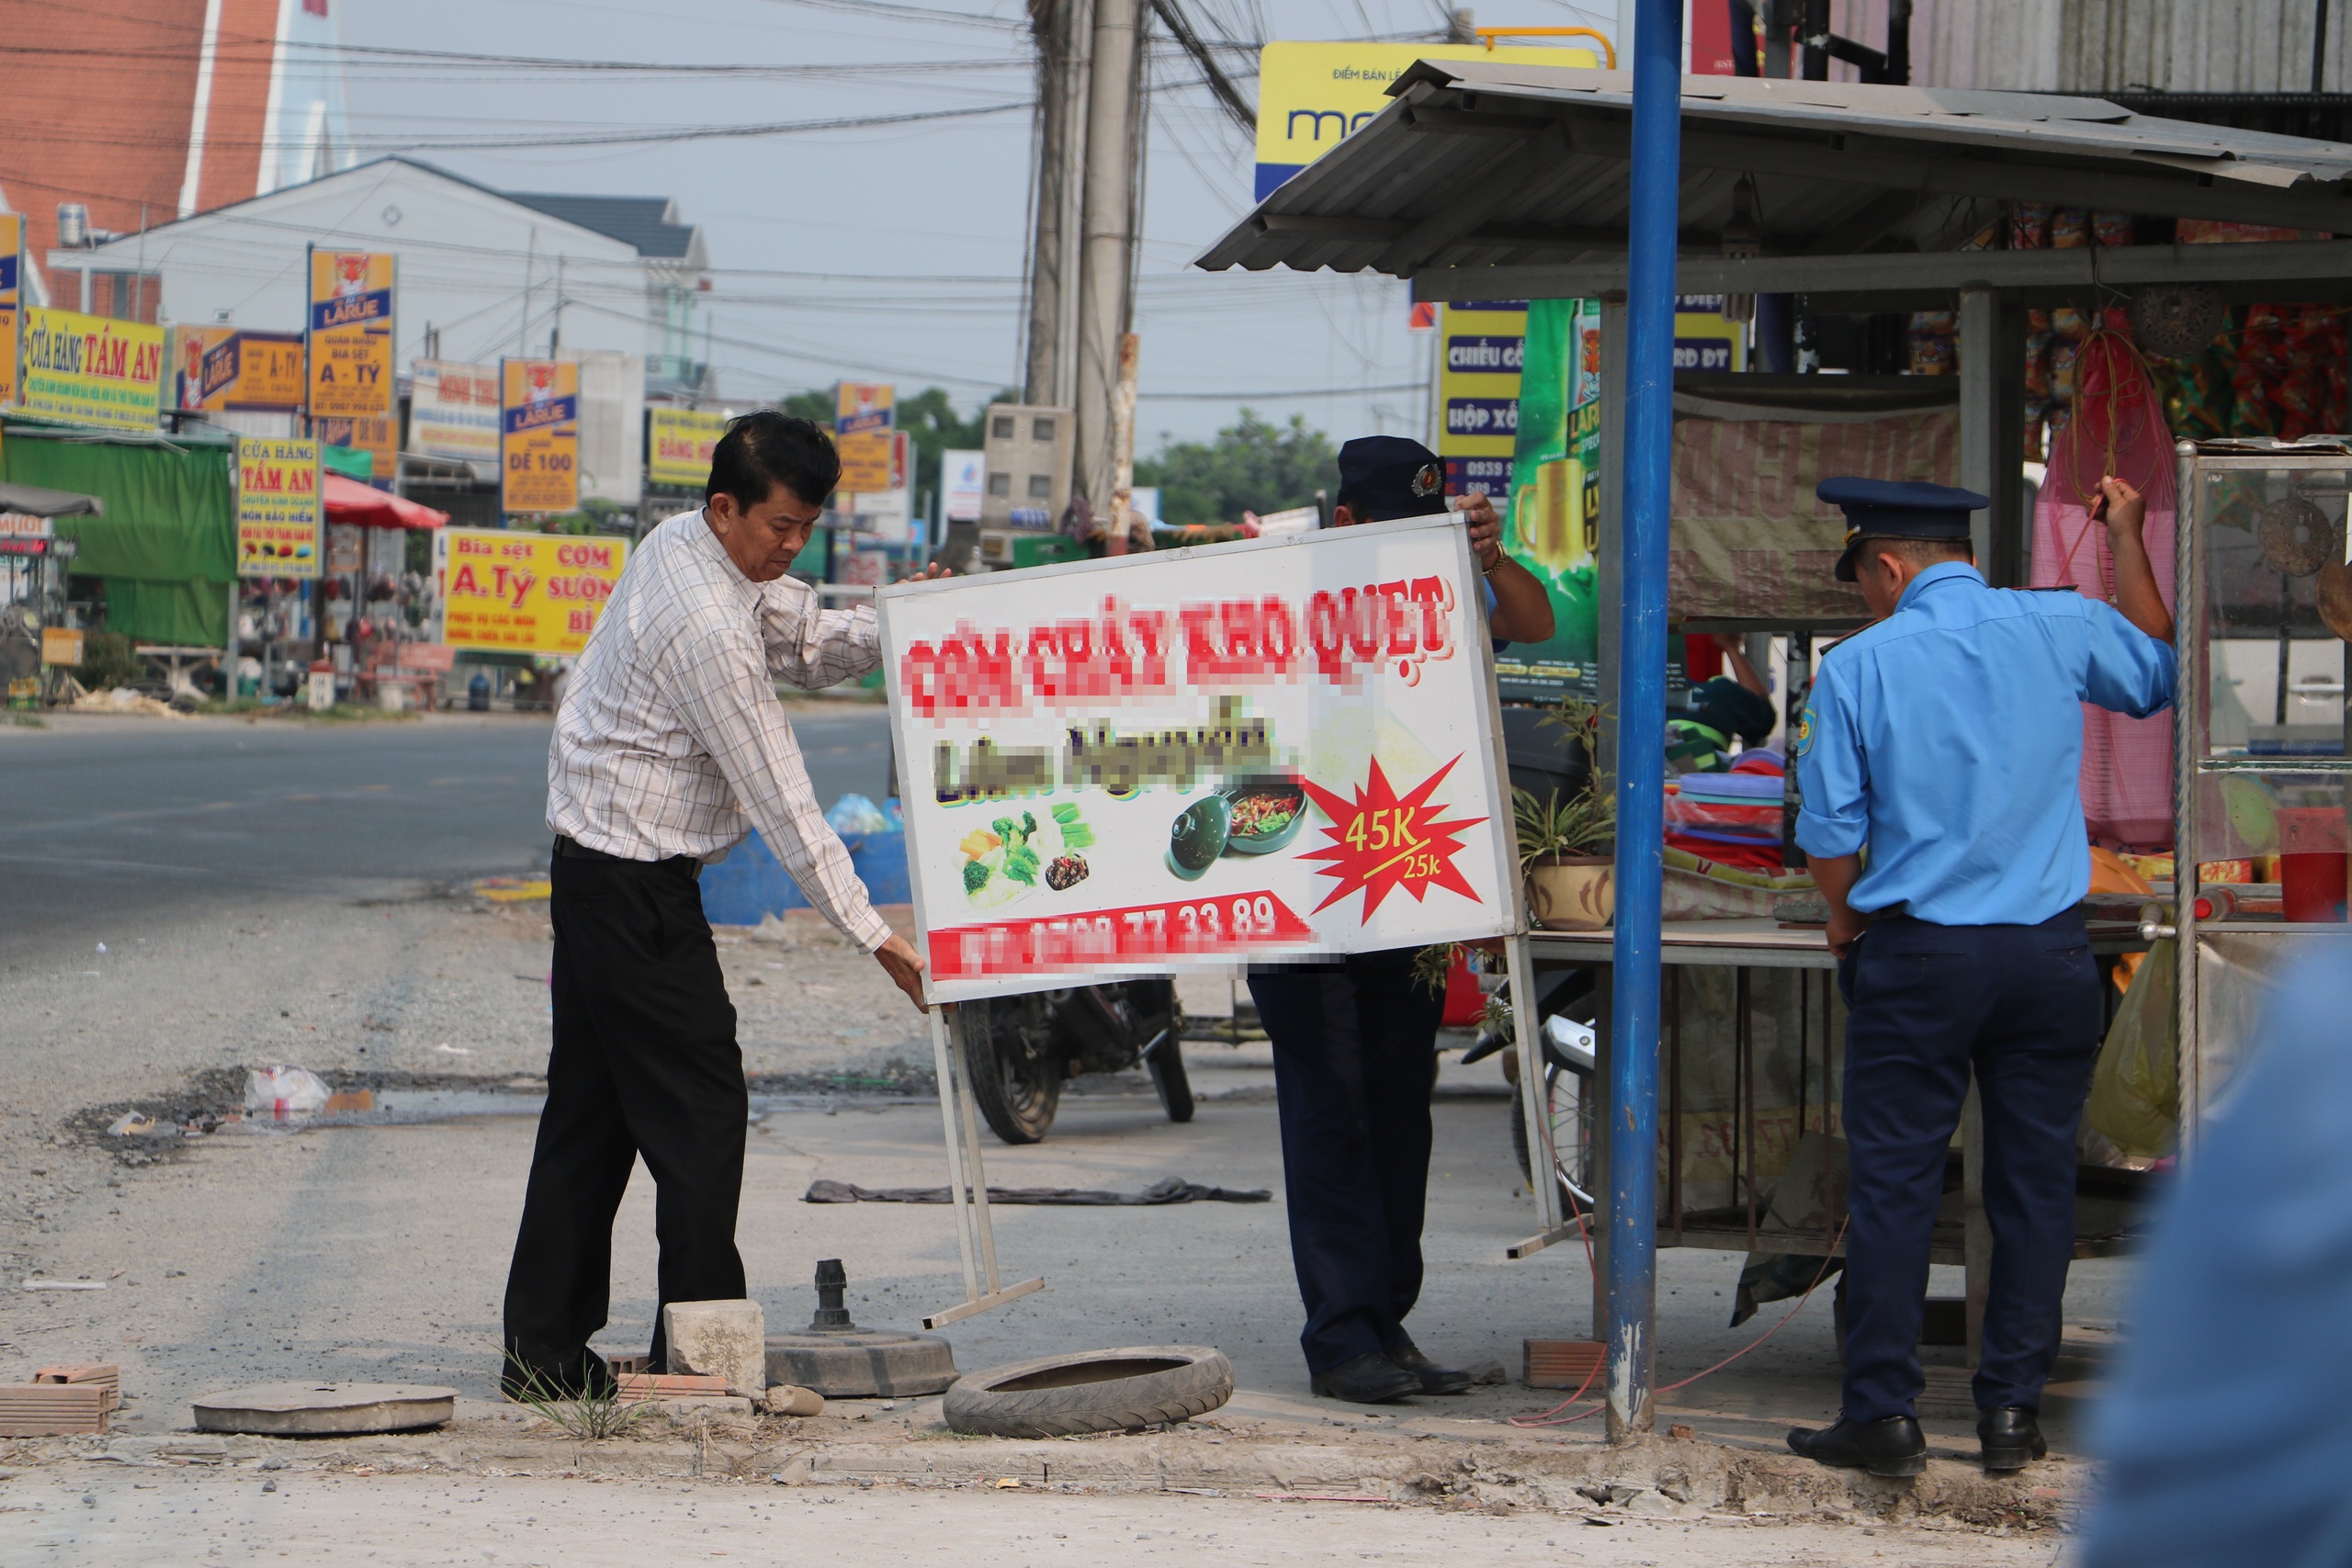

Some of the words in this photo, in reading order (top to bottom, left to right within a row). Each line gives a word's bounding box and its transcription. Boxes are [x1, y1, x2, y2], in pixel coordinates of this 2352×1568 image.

[1333, 64, 1360, 80] ĐIỂM
[1363, 67, 1386, 81] BÁN
[323, 299, 379, 326] LARUE
[30, 315, 51, 369] CỬA
[53, 322, 82, 374] HÀNG
[84, 322, 129, 379] TÁM
[130, 340, 162, 382] AN
[332, 349, 348, 359] BIA
[515, 403, 566, 429] LARUE
[1449, 403, 1490, 433] HỘP
[1569, 400, 1600, 439] LAR
[242, 441, 271, 457] CỬA
[275, 443, 313, 459] HÀNG
[538, 453, 571, 471] 100
[288, 468, 314, 492] AN
[458, 538, 493, 555] Bia
[502, 541, 534, 561] sệt
[557, 542, 612, 568] CƠM
[1345, 806, 1418, 852] 45K
[1404, 853, 1442, 879] 25k
